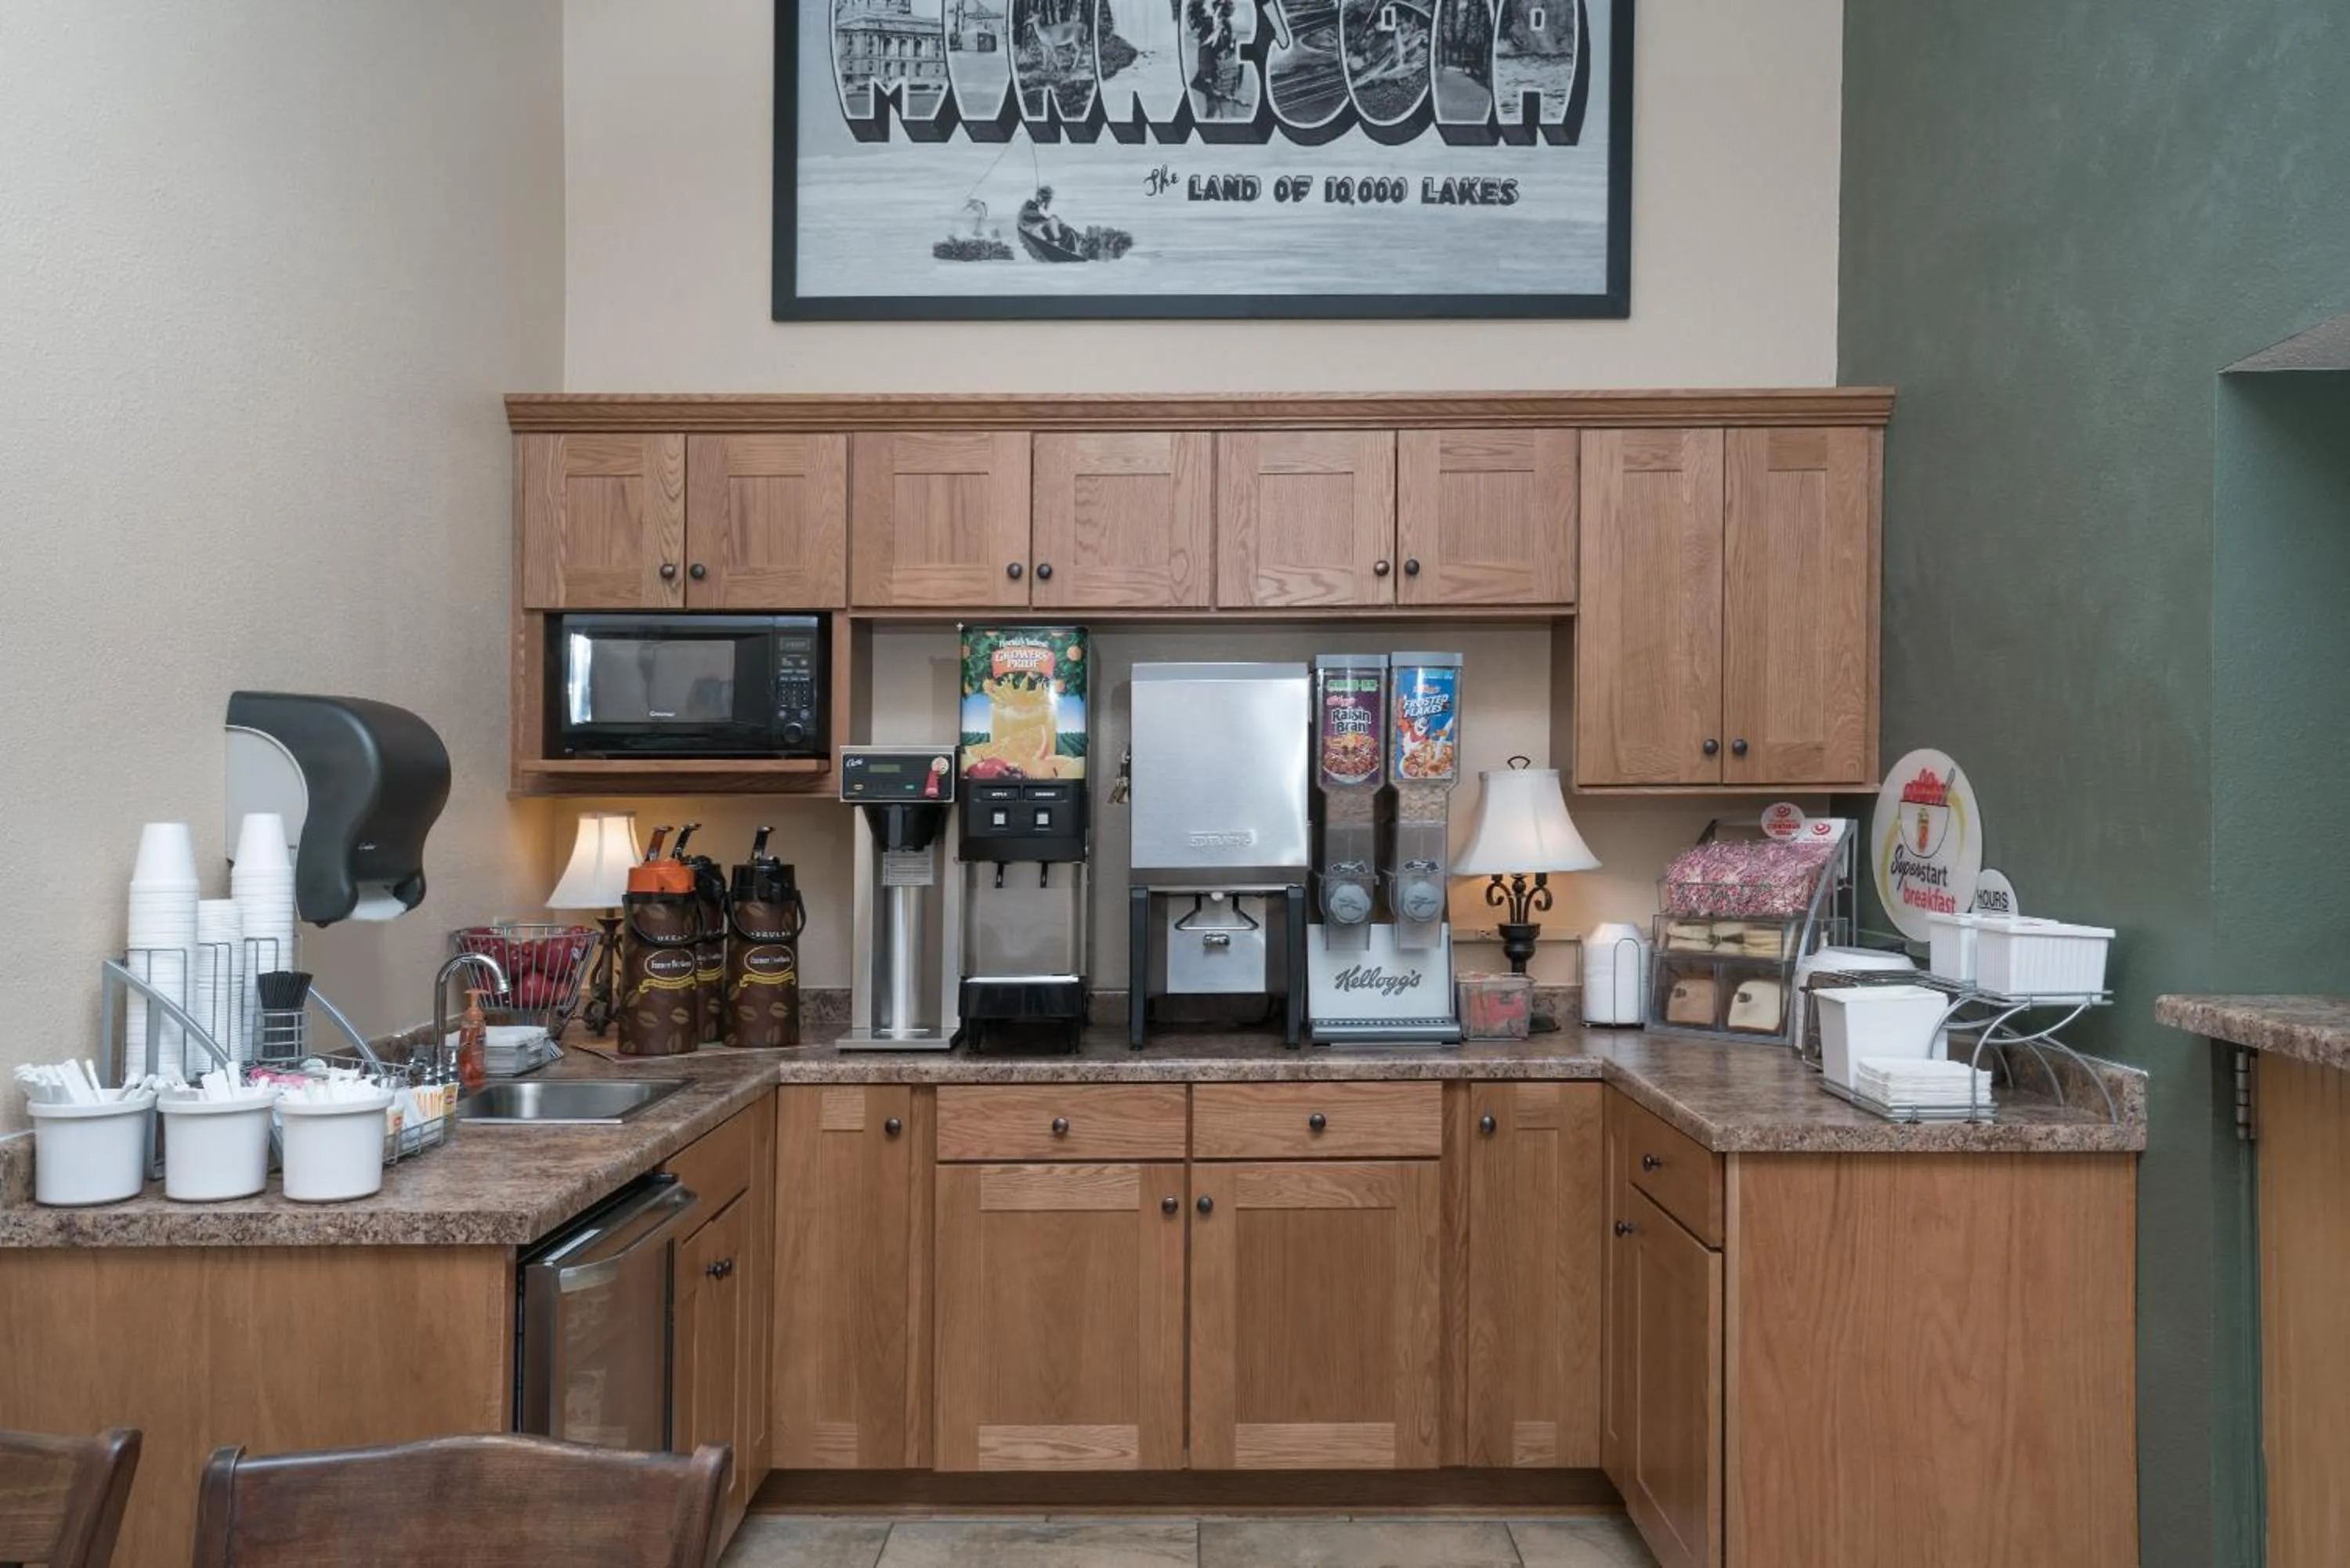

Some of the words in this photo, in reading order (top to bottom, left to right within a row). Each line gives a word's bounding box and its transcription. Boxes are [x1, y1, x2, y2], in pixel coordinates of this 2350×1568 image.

[1187, 174, 1261, 201] LAND
[1273, 175, 1314, 202] OF
[1420, 176, 1520, 206] LAKES
[1332, 707, 1372, 722] Raisin
[1404, 704, 1442, 718] FLAKES
[1336, 721, 1367, 733] Bran
[1903, 881, 1957, 914] breakfast
[1976, 888, 2009, 909] HOURS
[1333, 964, 1423, 996] Kellogg's
